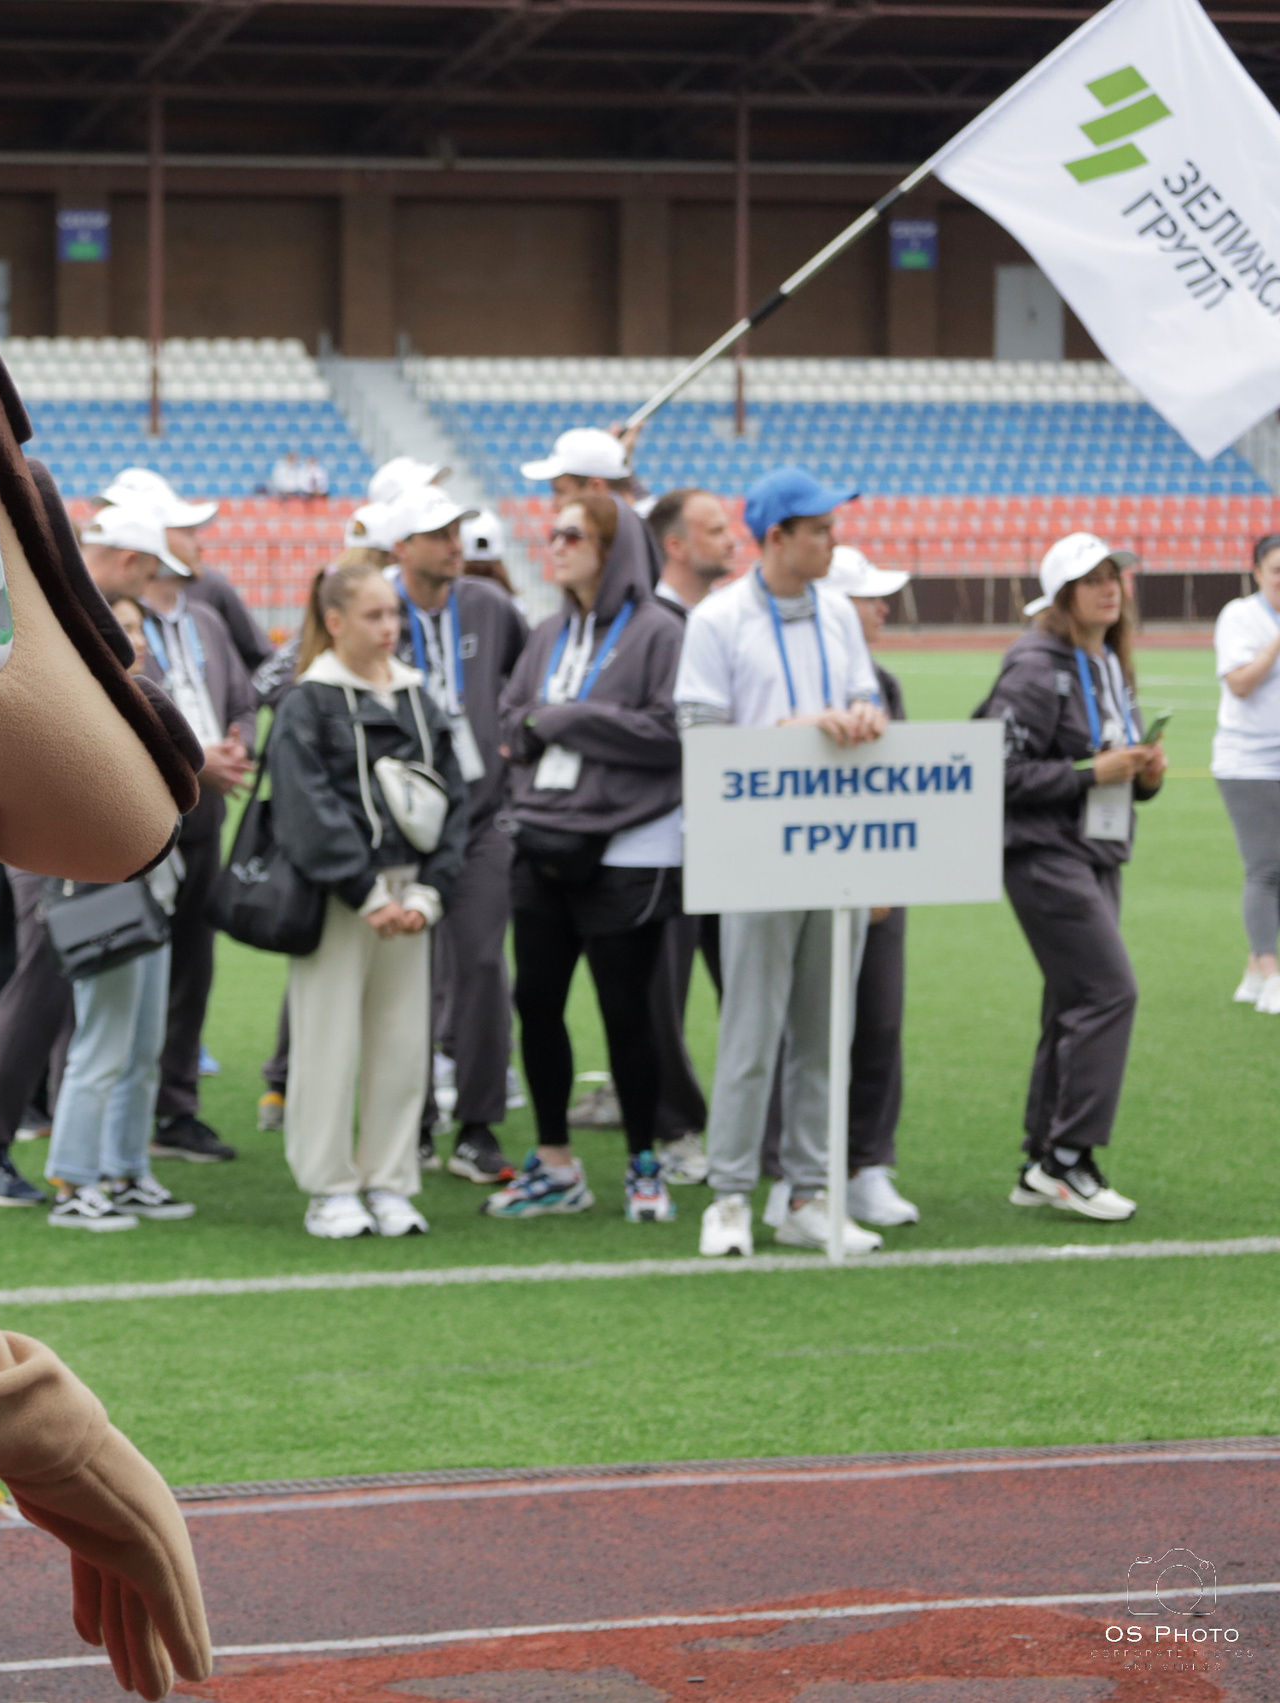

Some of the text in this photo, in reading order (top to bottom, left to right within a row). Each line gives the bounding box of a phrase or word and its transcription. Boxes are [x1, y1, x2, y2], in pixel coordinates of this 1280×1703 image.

[1121, 190, 1233, 311] ГРУПП
[722, 753, 974, 800] ЗЕЛИНСКИЙ
[782, 820, 918, 854] ГРУПП
